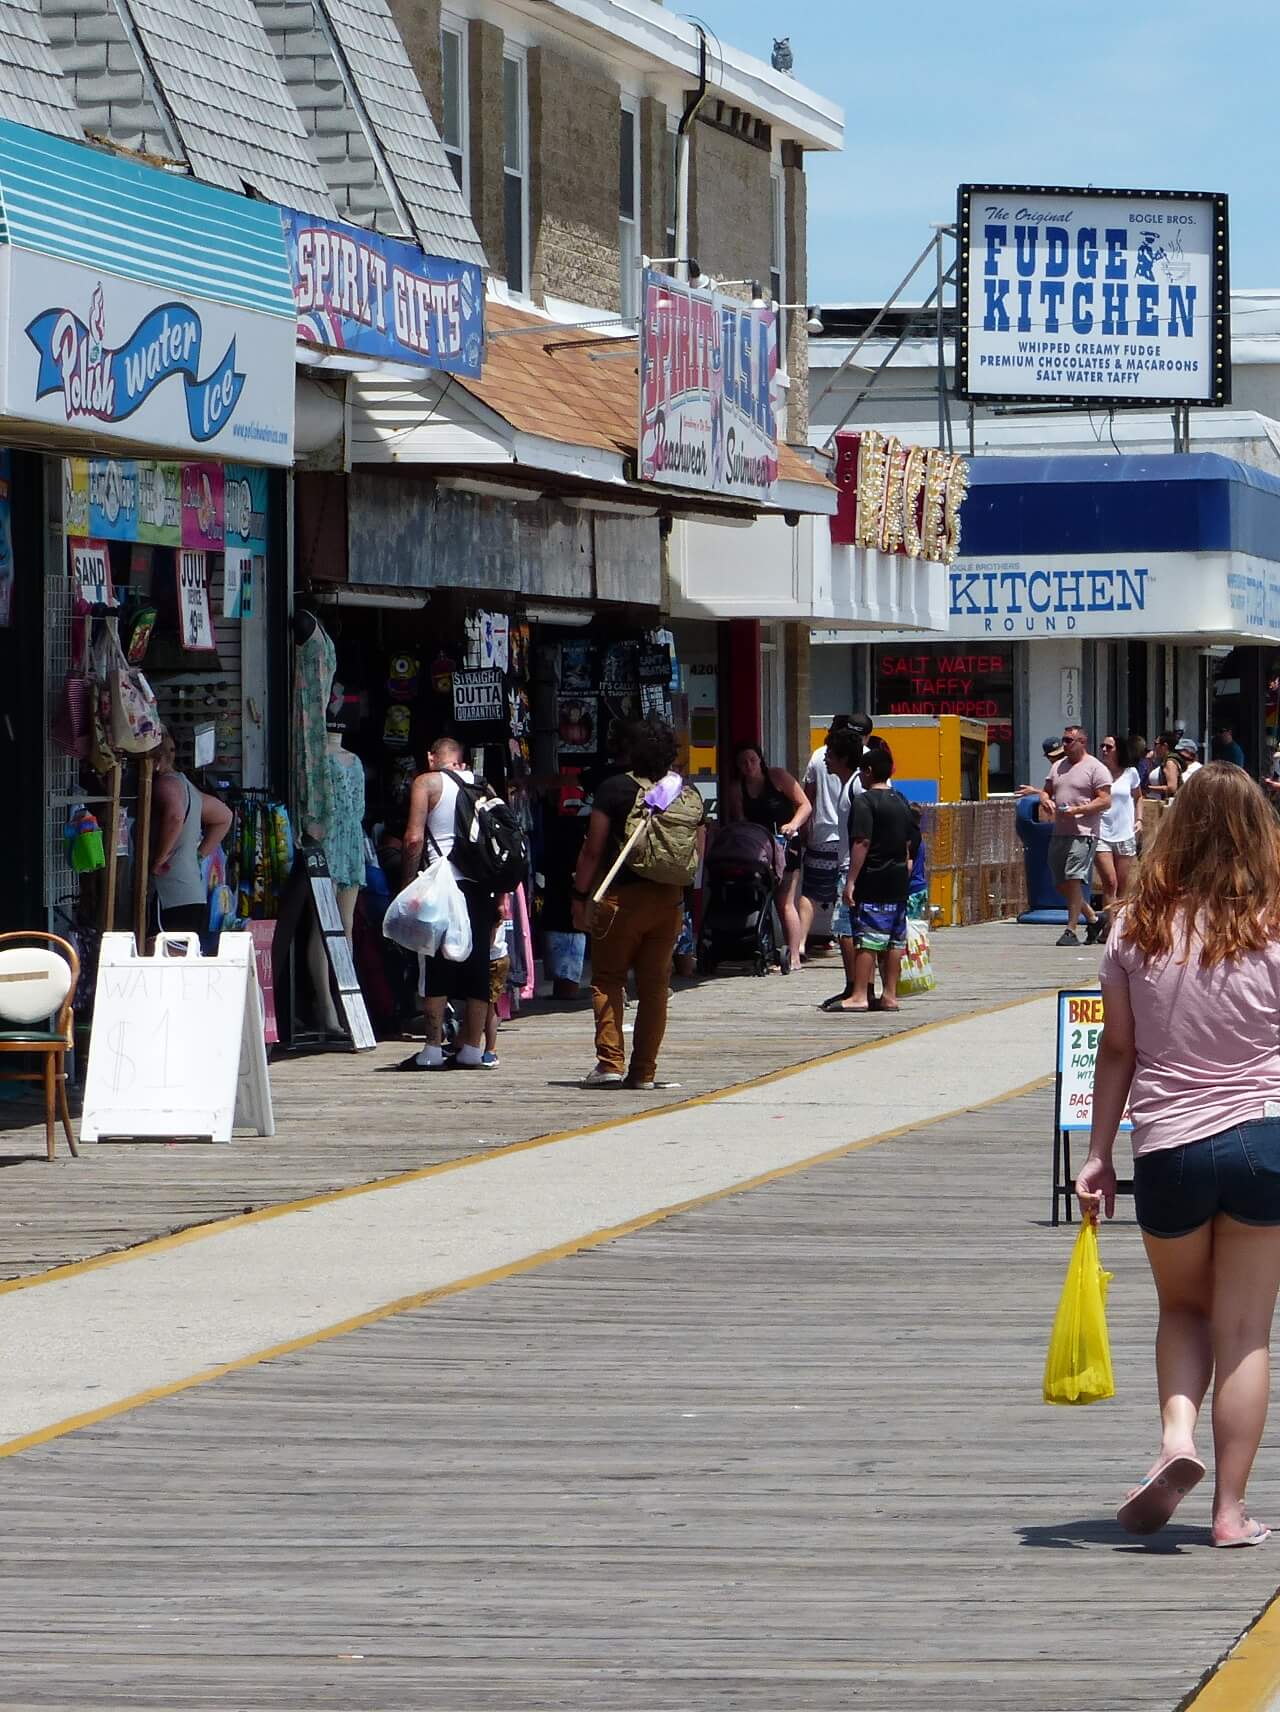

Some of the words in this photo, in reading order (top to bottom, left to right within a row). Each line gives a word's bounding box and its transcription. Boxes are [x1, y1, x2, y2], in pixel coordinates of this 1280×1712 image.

[985, 207, 1010, 220] The
[1014, 208, 1073, 225] Original
[1129, 214, 1163, 224] BOGLE
[1166, 215, 1197, 225] BROS.
[984, 224, 1128, 280] FUDGE
[297, 228, 388, 334] SPIRIT
[392, 266, 460, 357] GIFTS
[983, 279, 1197, 338] KITCHEN
[124, 311, 197, 400] water
[1018, 342, 1070, 354] WHIPPED
[1075, 343, 1120, 355] CREAMY
[1124, 345, 1161, 356] FUDGE
[54, 311, 114, 420] Polish
[980, 355, 1034, 367] PREMIUM
[1038, 357, 1110, 369] CHOCOLATES
[1114, 359, 1122, 370] &
[1127, 359, 1199, 371] MACAROONS
[1036, 370, 1062, 382] SALT
[1066, 371, 1103, 383] WATER
[1107, 372, 1140, 384] TAFFY
[654, 409, 708, 478] Beachwear
[75, 556, 106, 587] SAND
[949, 562, 973, 572] OGLE
[949, 569, 1148, 615] KITCHEN
[984, 616, 1077, 632] ROUND
[881, 656, 929, 675] SALT
[936, 656, 1005, 674] WATER
[454, 671, 502, 686] STRAIGHT
[911, 678, 974, 697] TAFFY
[456, 686, 501, 704] OUTTA
[1064, 670, 1076, 718] 4120
[457, 705, 502, 720] QUARANTINE
[940, 700, 999, 717] DIPPED
[103, 968, 224, 1001] WATER
[1068, 999, 1105, 1023] BRE
[1071, 1029, 1082, 1049] 2
[99, 1008, 184, 1097] $1
[1076, 1109, 1088, 1119] OR
